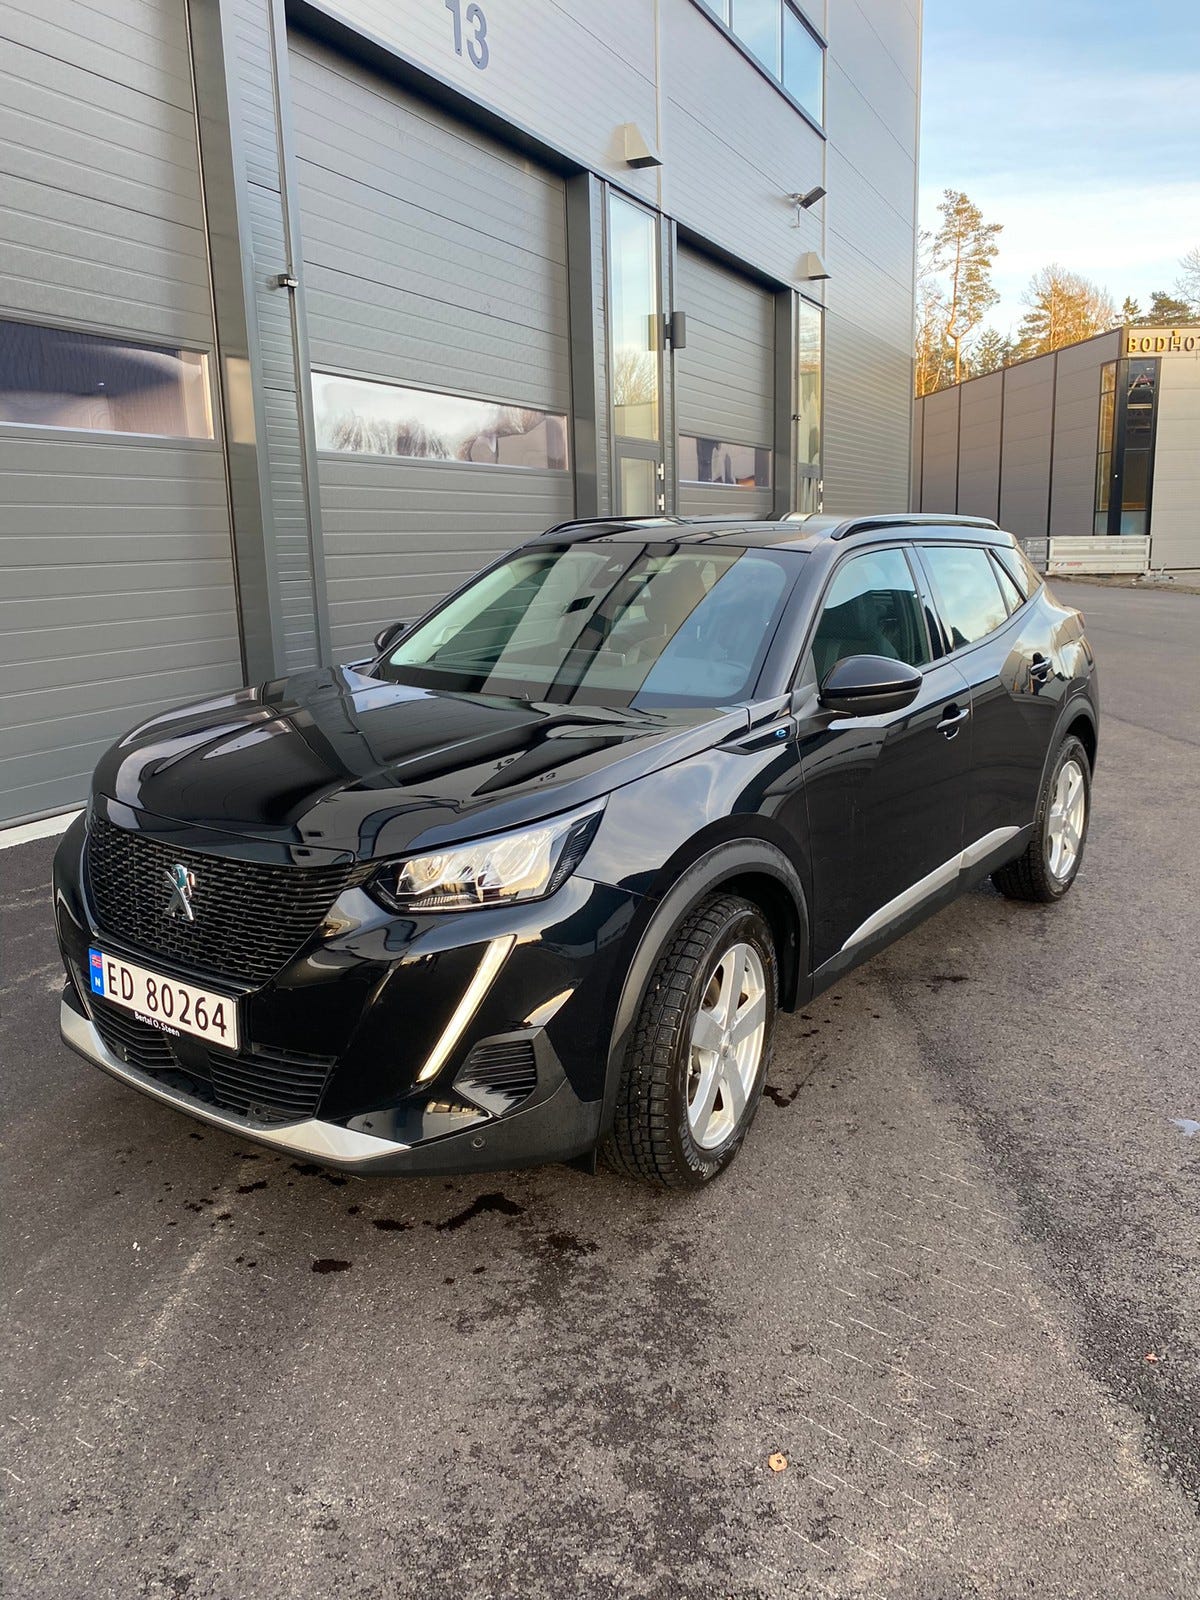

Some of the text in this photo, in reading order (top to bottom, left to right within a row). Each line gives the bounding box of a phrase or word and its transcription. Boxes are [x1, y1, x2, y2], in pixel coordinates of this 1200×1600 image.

[445, 0, 489, 70] 13
[1127, 335, 1200, 352] BODHO
[95, 977, 101, 987] N
[107, 962, 227, 1037] ED 80264
[160, 1022, 180, 1037] Steen
